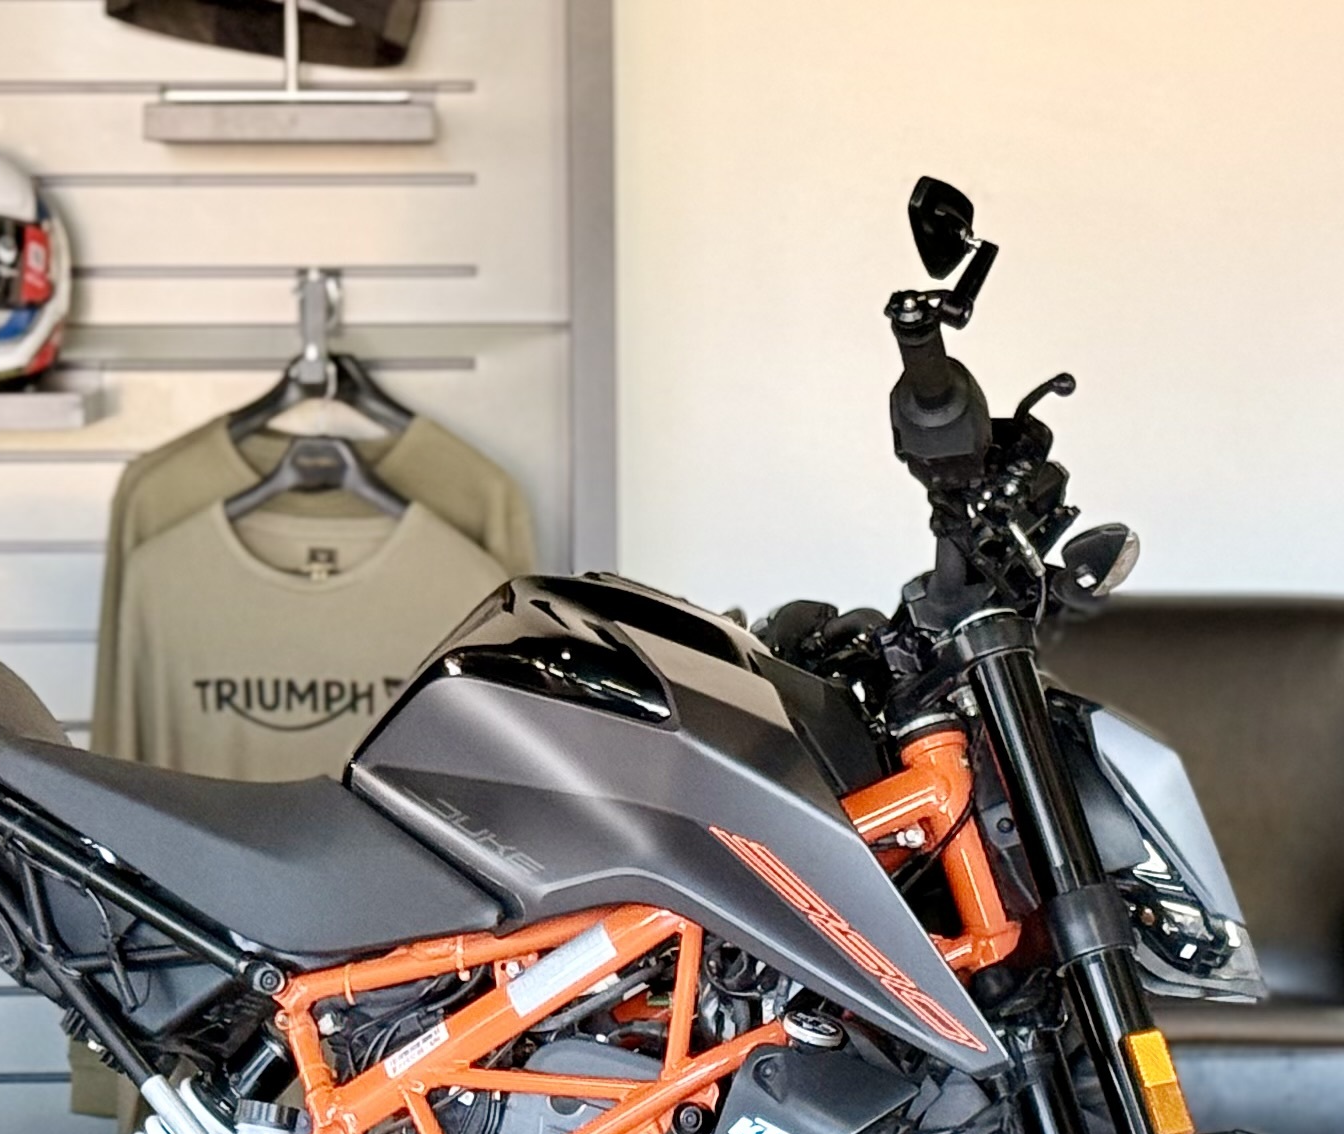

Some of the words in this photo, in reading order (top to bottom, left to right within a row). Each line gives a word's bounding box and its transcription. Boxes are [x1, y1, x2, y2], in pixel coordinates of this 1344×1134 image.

[193, 677, 374, 731] TRIUMPH
[403, 786, 545, 875] DUKE
[709, 826, 988, 1051] 390
